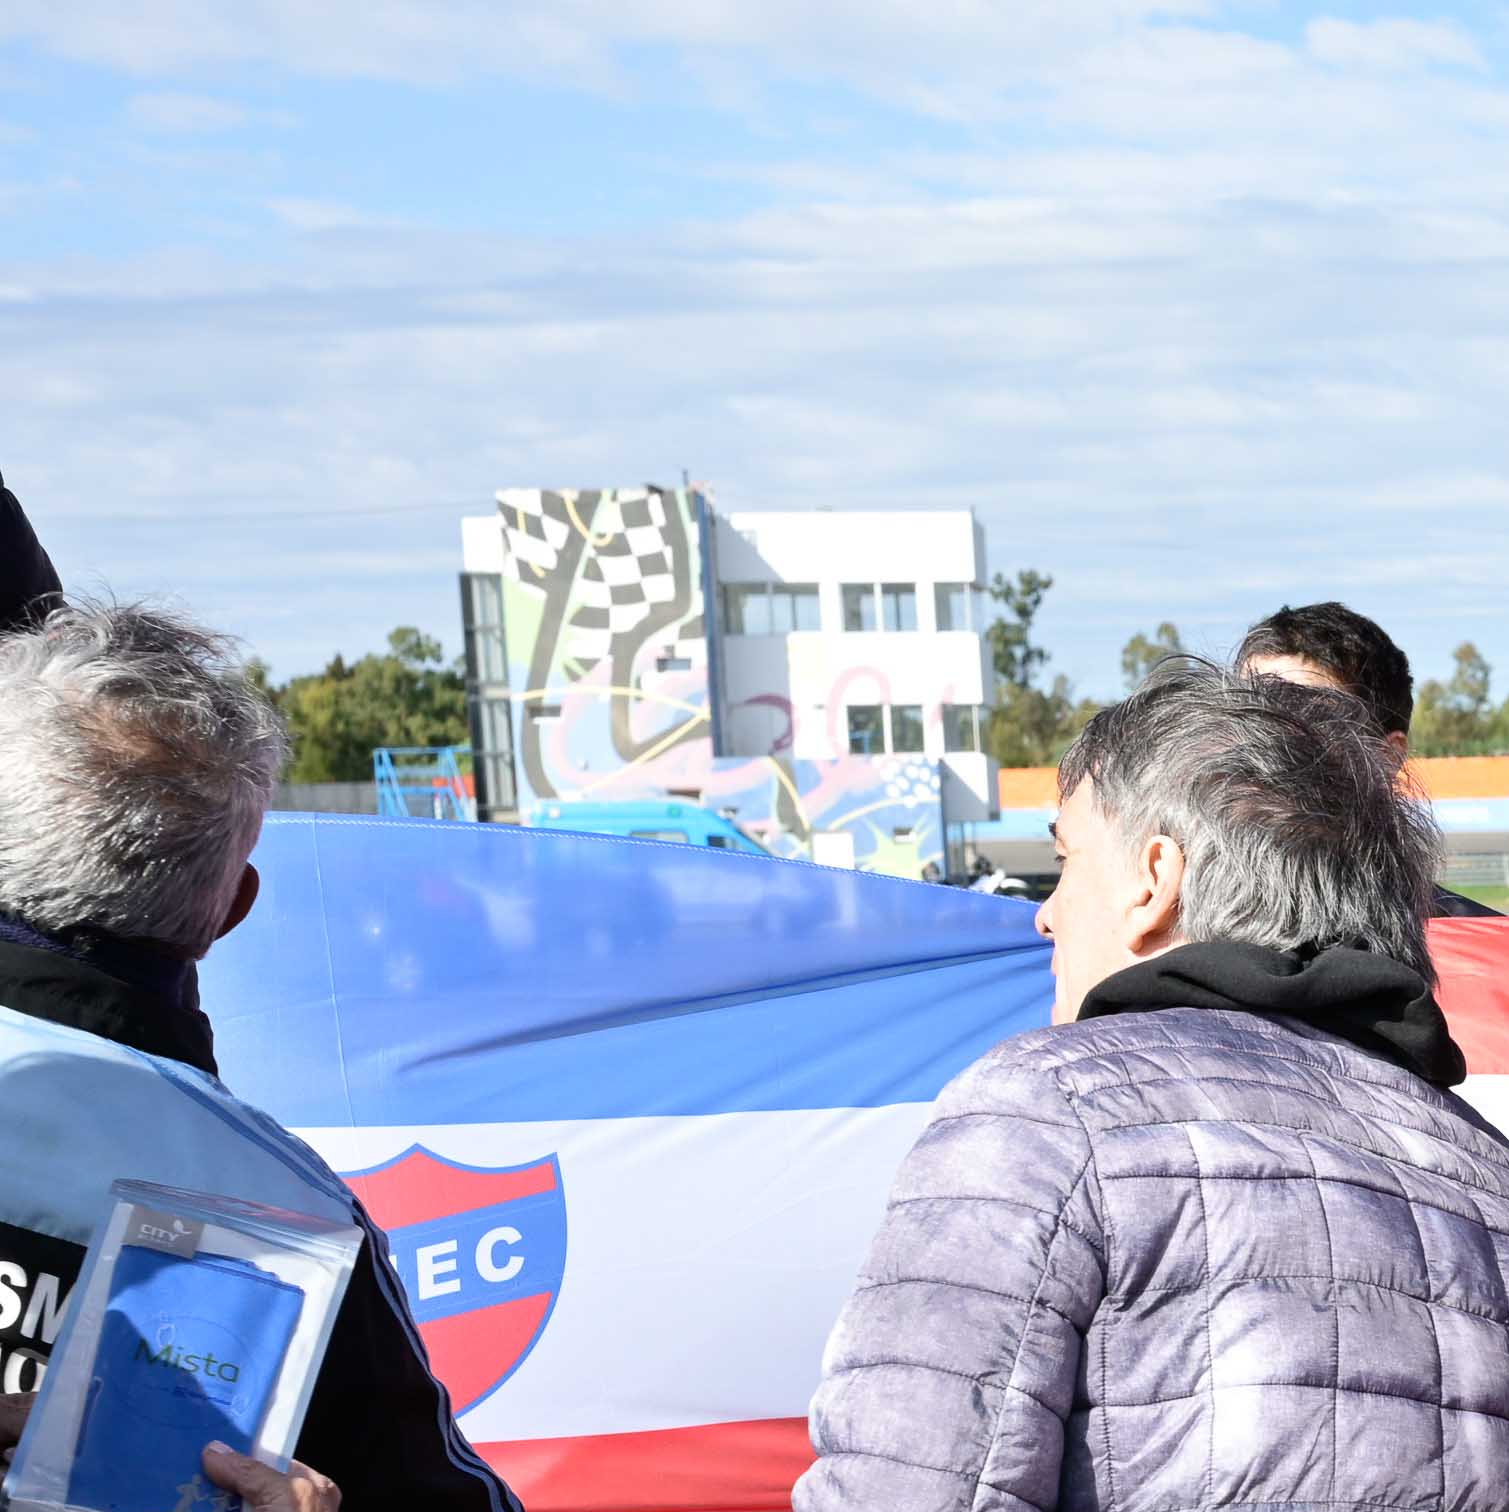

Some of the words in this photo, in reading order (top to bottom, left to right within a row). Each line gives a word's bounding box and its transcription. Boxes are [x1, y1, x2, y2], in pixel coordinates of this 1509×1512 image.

[139, 1223, 181, 1243] CITY
[388, 1226, 525, 1301] EC
[132, 1339, 241, 1384] Mista
